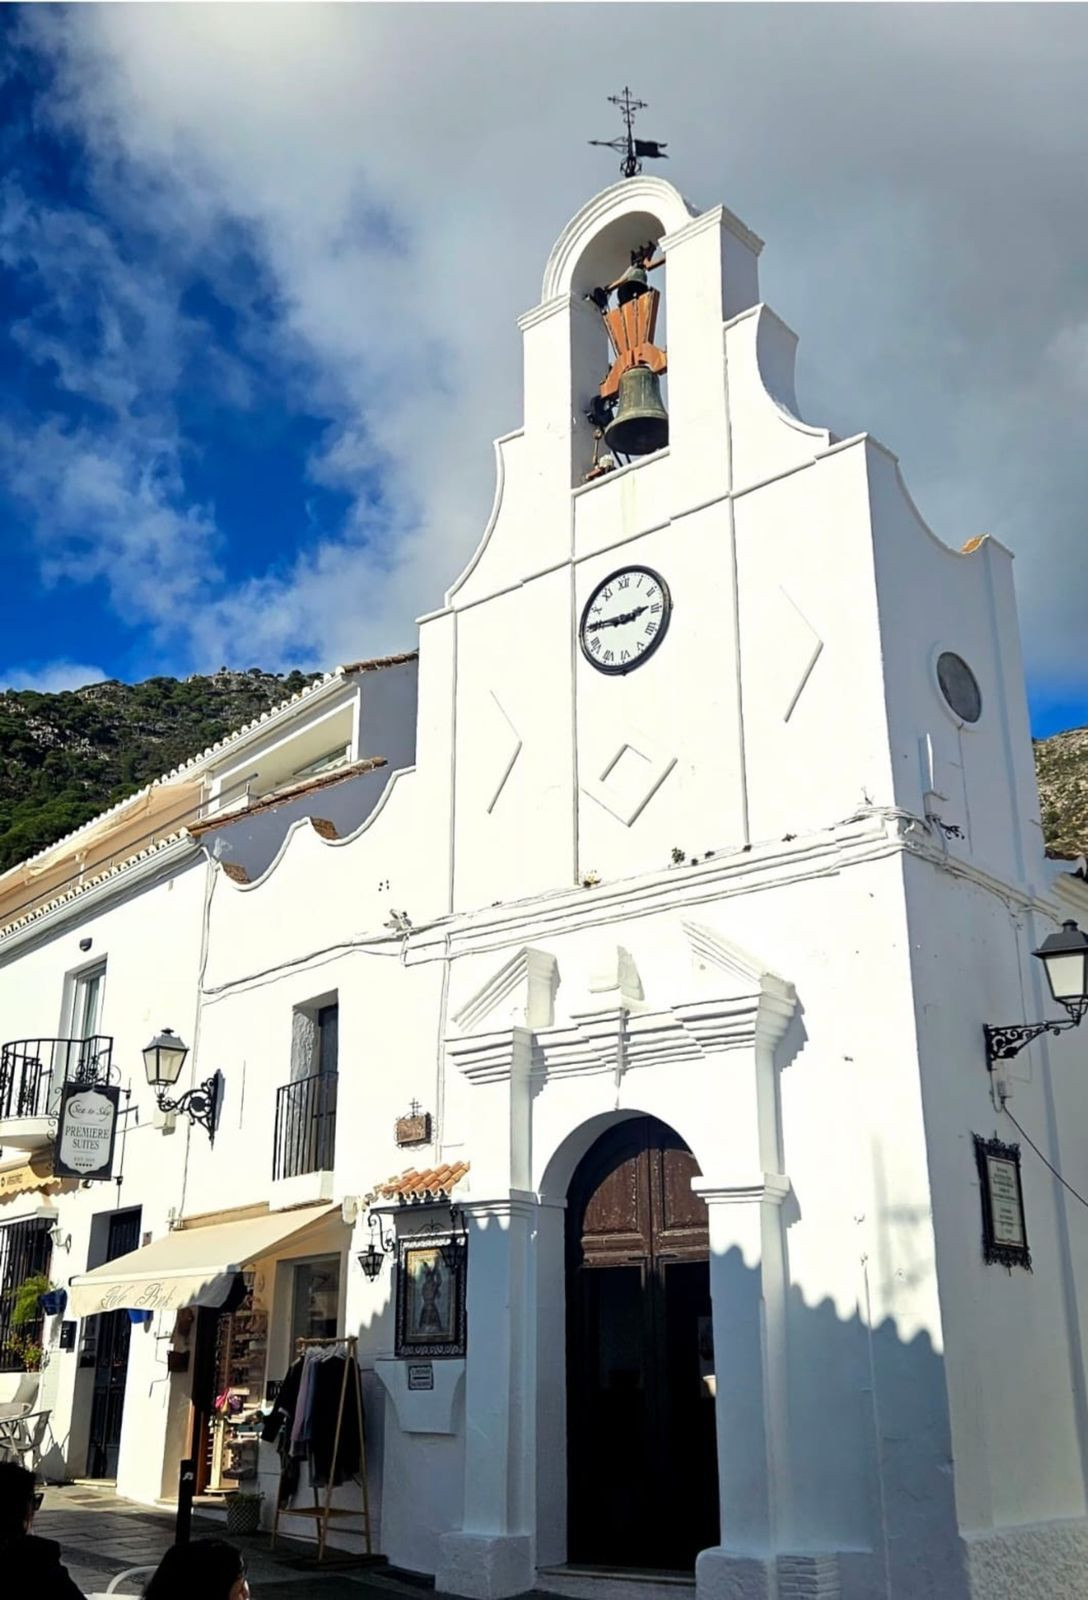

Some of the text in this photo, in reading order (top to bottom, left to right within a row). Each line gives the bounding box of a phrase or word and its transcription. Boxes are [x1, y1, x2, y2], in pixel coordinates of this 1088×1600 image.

[618, 577, 630, 591] XII
[602, 588, 614, 602] XI
[650, 602, 660, 614] III
[65, 1125, 109, 1140] PREMIERE
[72, 1139, 100, 1150] SUITES
